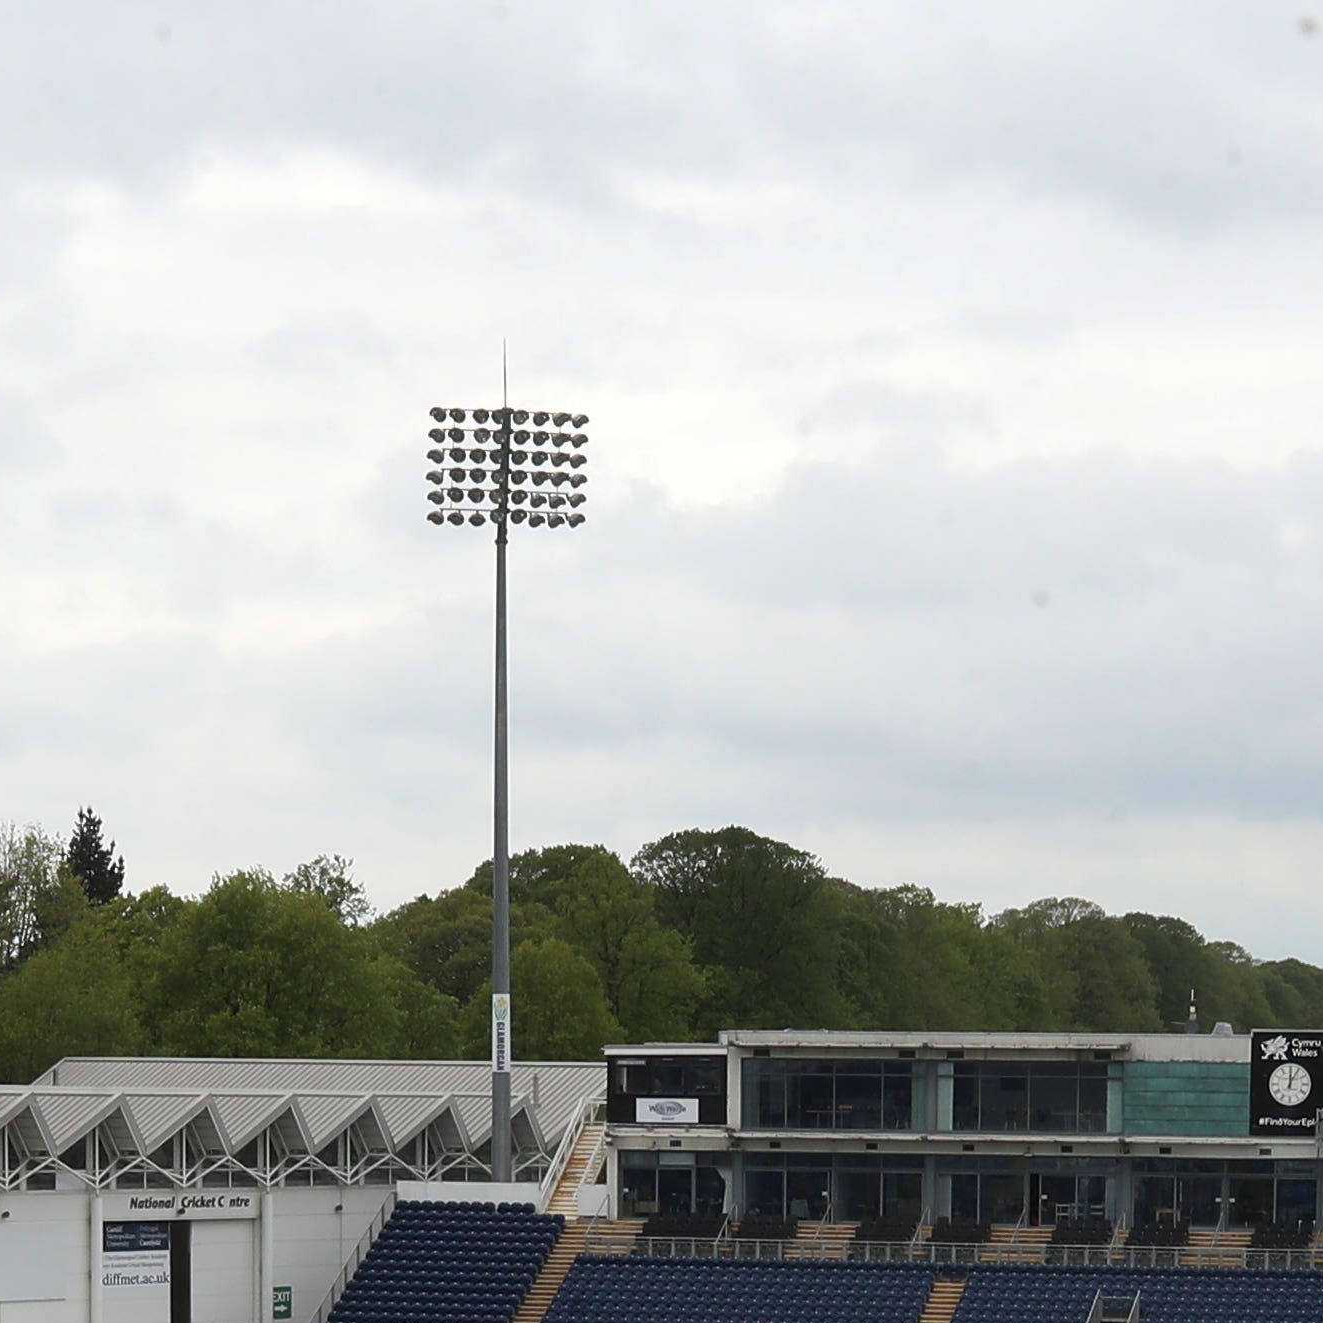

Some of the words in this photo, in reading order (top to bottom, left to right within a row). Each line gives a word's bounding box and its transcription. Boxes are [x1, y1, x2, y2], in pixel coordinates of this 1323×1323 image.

[1291, 1038, 1322, 1048] Cymru
[1291, 1048, 1318, 1057] Wales
[129, 1197, 176, 1210] National
[181, 1196, 217, 1209] Cricket
